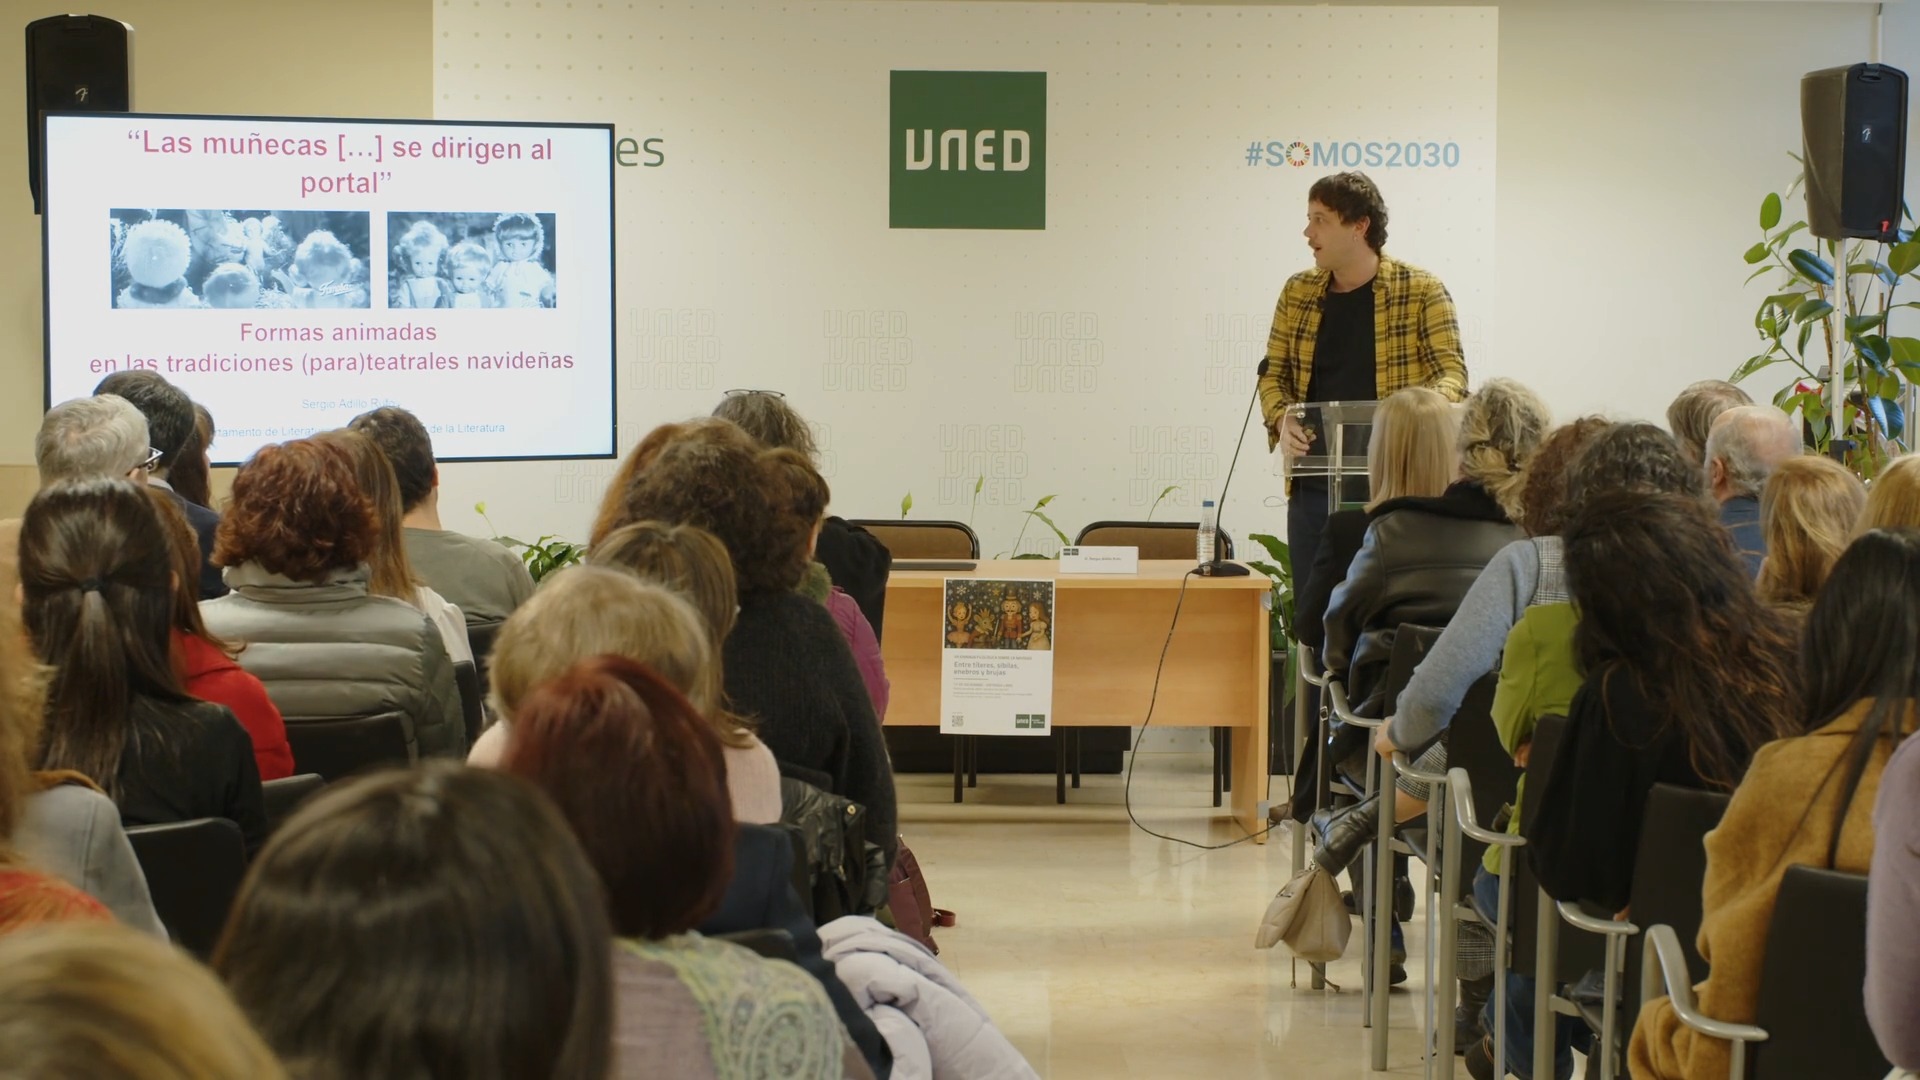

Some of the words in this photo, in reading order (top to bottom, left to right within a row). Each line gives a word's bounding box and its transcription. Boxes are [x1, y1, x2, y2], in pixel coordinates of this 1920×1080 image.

[128, 129, 193, 154] “Las
[203, 132, 329, 157] muñecas
[393, 140, 423, 160] se
[432, 136, 522, 165] dirigen
[531, 138, 552, 160] al
[906, 129, 1030, 172] UNED
[1245, 140, 1461, 168] #SOMOS2030
[301, 171, 392, 199] portal”
[241, 322, 325, 342] Formas
[332, 322, 437, 342] animadas
[1205, 313, 1270, 341] UNE
[89, 357, 118, 373] en
[126, 353, 158, 372] las
[167, 353, 294, 373] tradiciones
[302, 351, 459, 376] (para)teatrales
[467, 350, 574, 370] navideñas
[302, 399, 336, 411] Sergio
[214, 427, 262, 438] rtamento
[264, 427, 278, 437] de
[429, 424, 443, 434] de
[446, 423, 454, 434] la
[457, 423, 505, 434] Literatura
[986, 669, 1007, 677] brujas
